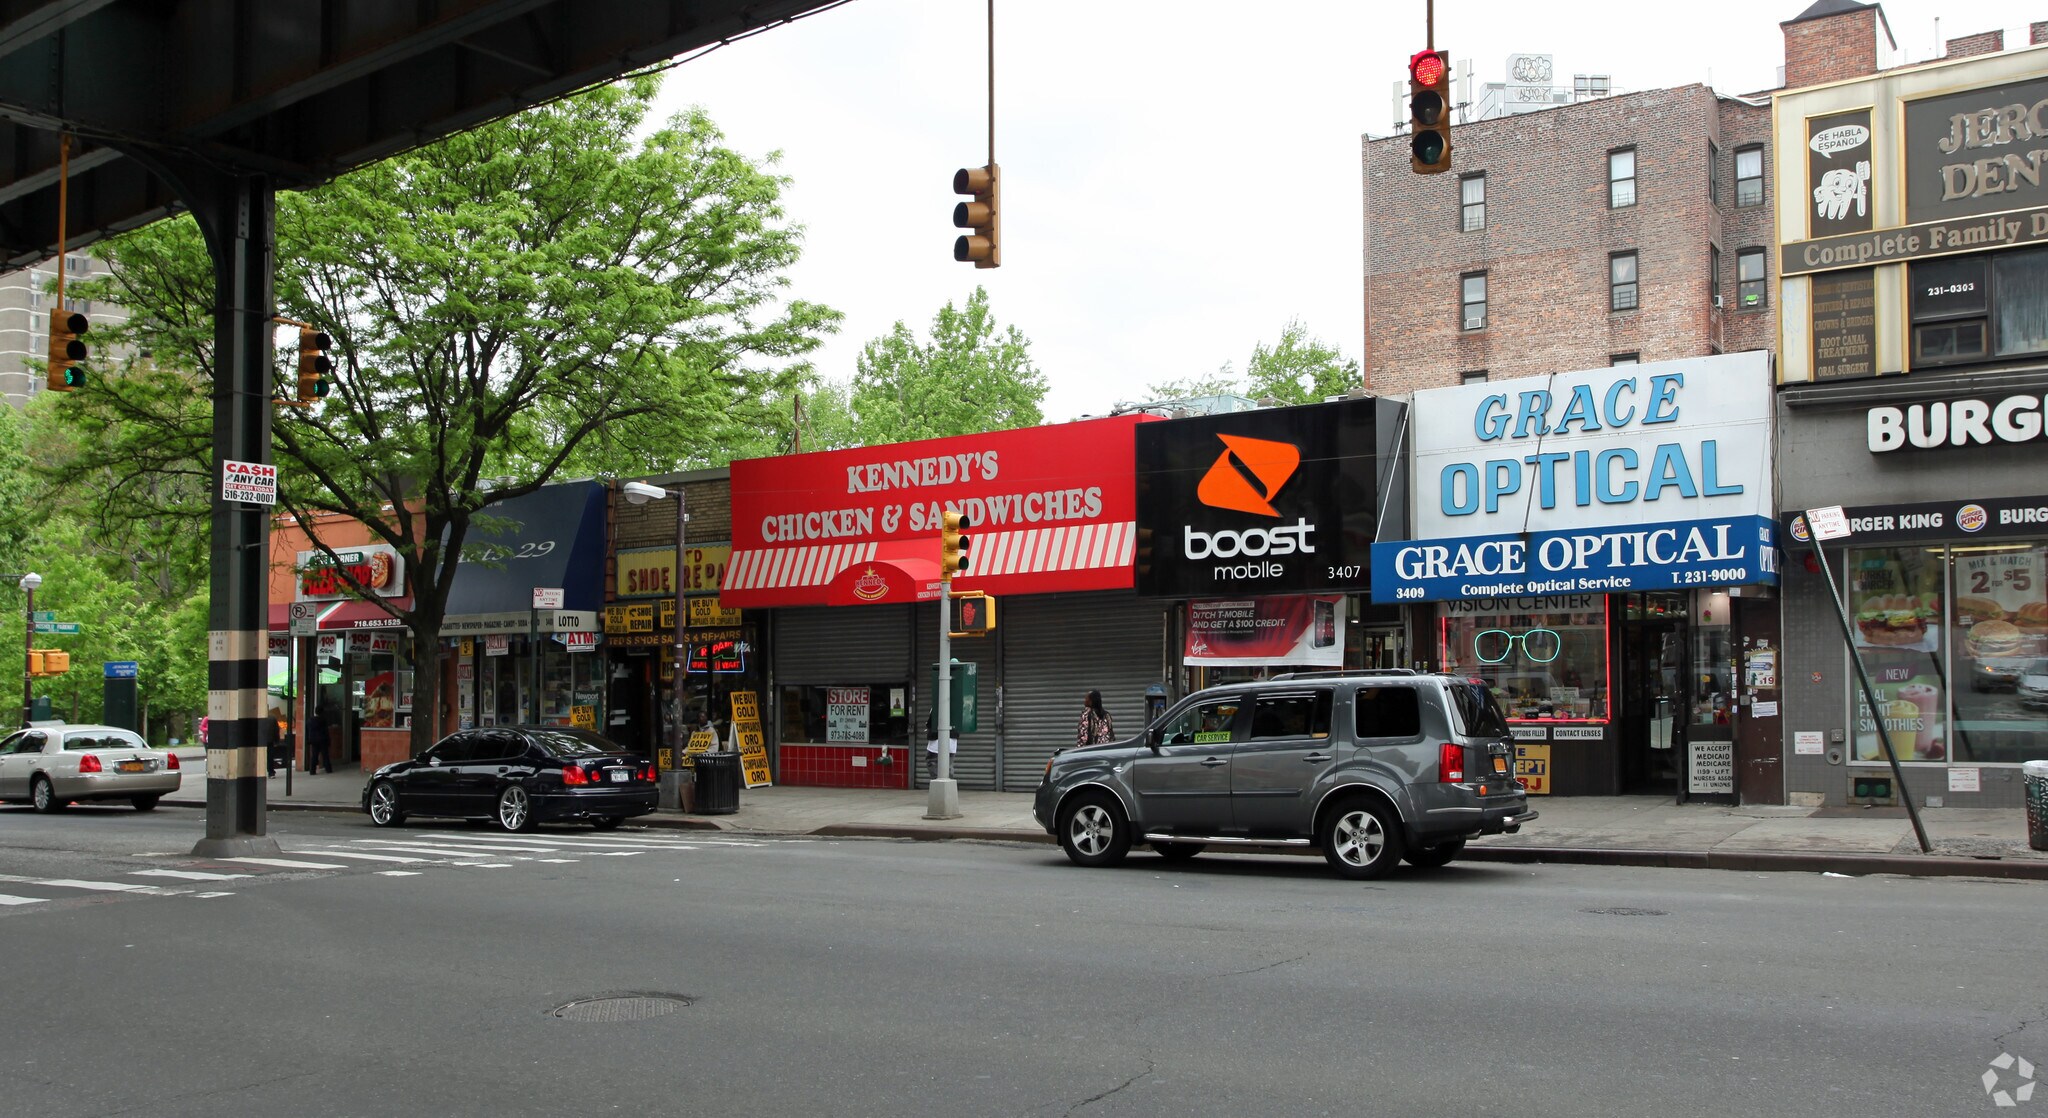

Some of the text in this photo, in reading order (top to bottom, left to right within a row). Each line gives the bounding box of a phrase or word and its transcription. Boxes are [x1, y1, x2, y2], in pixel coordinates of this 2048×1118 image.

[1818, 128, 1862, 142] SE HABLA
[1818, 136, 1860, 151] ESPAÑOL
[1940, 150, 2048, 202] DEN
[1803, 216, 2022, 268] Complete Family
[1927, 283, 1975, 297] 231-0303
[1815, 319, 1839, 331] CROWNS
[1846, 315, 1873, 327] BRIDGES
[1820, 334, 1866, 345] ROOT CANAL
[1818, 344, 1869, 359] TREATMENT
[1818, 362, 1869, 377] ORAL SURGERY
[1475, 373, 1683, 441] GRACE
[1868, 394, 2048, 452] BURG
[847, 450, 998, 494] KENNEDY'S
[1440, 440, 1744, 516] OPTICAL
[233, 474, 274, 486] ANY CAR
[225, 490, 274, 502] 516-232-0007
[1821, 510, 1841, 519] PARKING
[1960, 510, 1983, 519] BURGER
[1961, 515, 1983, 526] KING
[761, 507, 873, 543] CHICKEN
[881, 503, 903, 533] &
[1818, 520, 1841, 529] ANYTIME
[1848, 512, 1943, 532] RGER KING
[1185, 517, 1315, 560] boost
[516, 541, 555, 558] 29
[1395, 525, 1745, 580] GRACE OPTICAL
[1969, 558, 1986, 570] MIX
[2000, 556, 2031, 567] MATCH
[1214, 561, 1283, 580] mobile
[1328, 566, 1360, 578] 3407
[1672, 567, 1746, 584] T. 231-9000
[628, 567, 670, 592] SHOE
[1971, 571, 1990, 593] 2
[2004, 568, 2031, 591] $5
[1461, 575, 1631, 597] Complete Optical Service
[1396, 587, 1425, 599] 3409
[661, 601, 670, 611] TED
[702, 600, 713, 608] BUY
[1447, 595, 1592, 612] VISION CENTER
[607, 607, 626, 615] WE BUY
[637, 608, 652, 616] SHOE
[1218, 610, 1254, 619] T-MOBILE
[354, 619, 401, 627] 718.653.1525
[558, 616, 579, 628] LOTTO
[610, 616, 623, 624] GOLD
[630, 620, 652, 631] REPAIR
[1192, 619, 1286, 628] AND GET A $100 CREDIT.
[568, 632, 594, 645] ATM
[661, 633, 690, 644] SAS
[700, 641, 734, 657] RPAIR
[1886, 669, 1908, 680] NEW
[1760, 677, 1774, 685] $19
[575, 692, 599, 700] Newport
[733, 693, 756, 704] WE BUY
[829, 689, 868, 703] STORE
[1859, 690, 1887, 702] RAL
[572, 707, 592, 716] WE BUY
[737, 706, 755, 717] GOLD
[830, 705, 866, 716] FOR RENT
[1859, 704, 1892, 717] FRIT
[576, 714, 591, 723] GOLD
[1859, 718, 1925, 732] SMOTHIES
[745, 734, 759, 745] ORO
[1207, 733, 1228, 741] SERVICE
[752, 770, 766, 782] ORO
